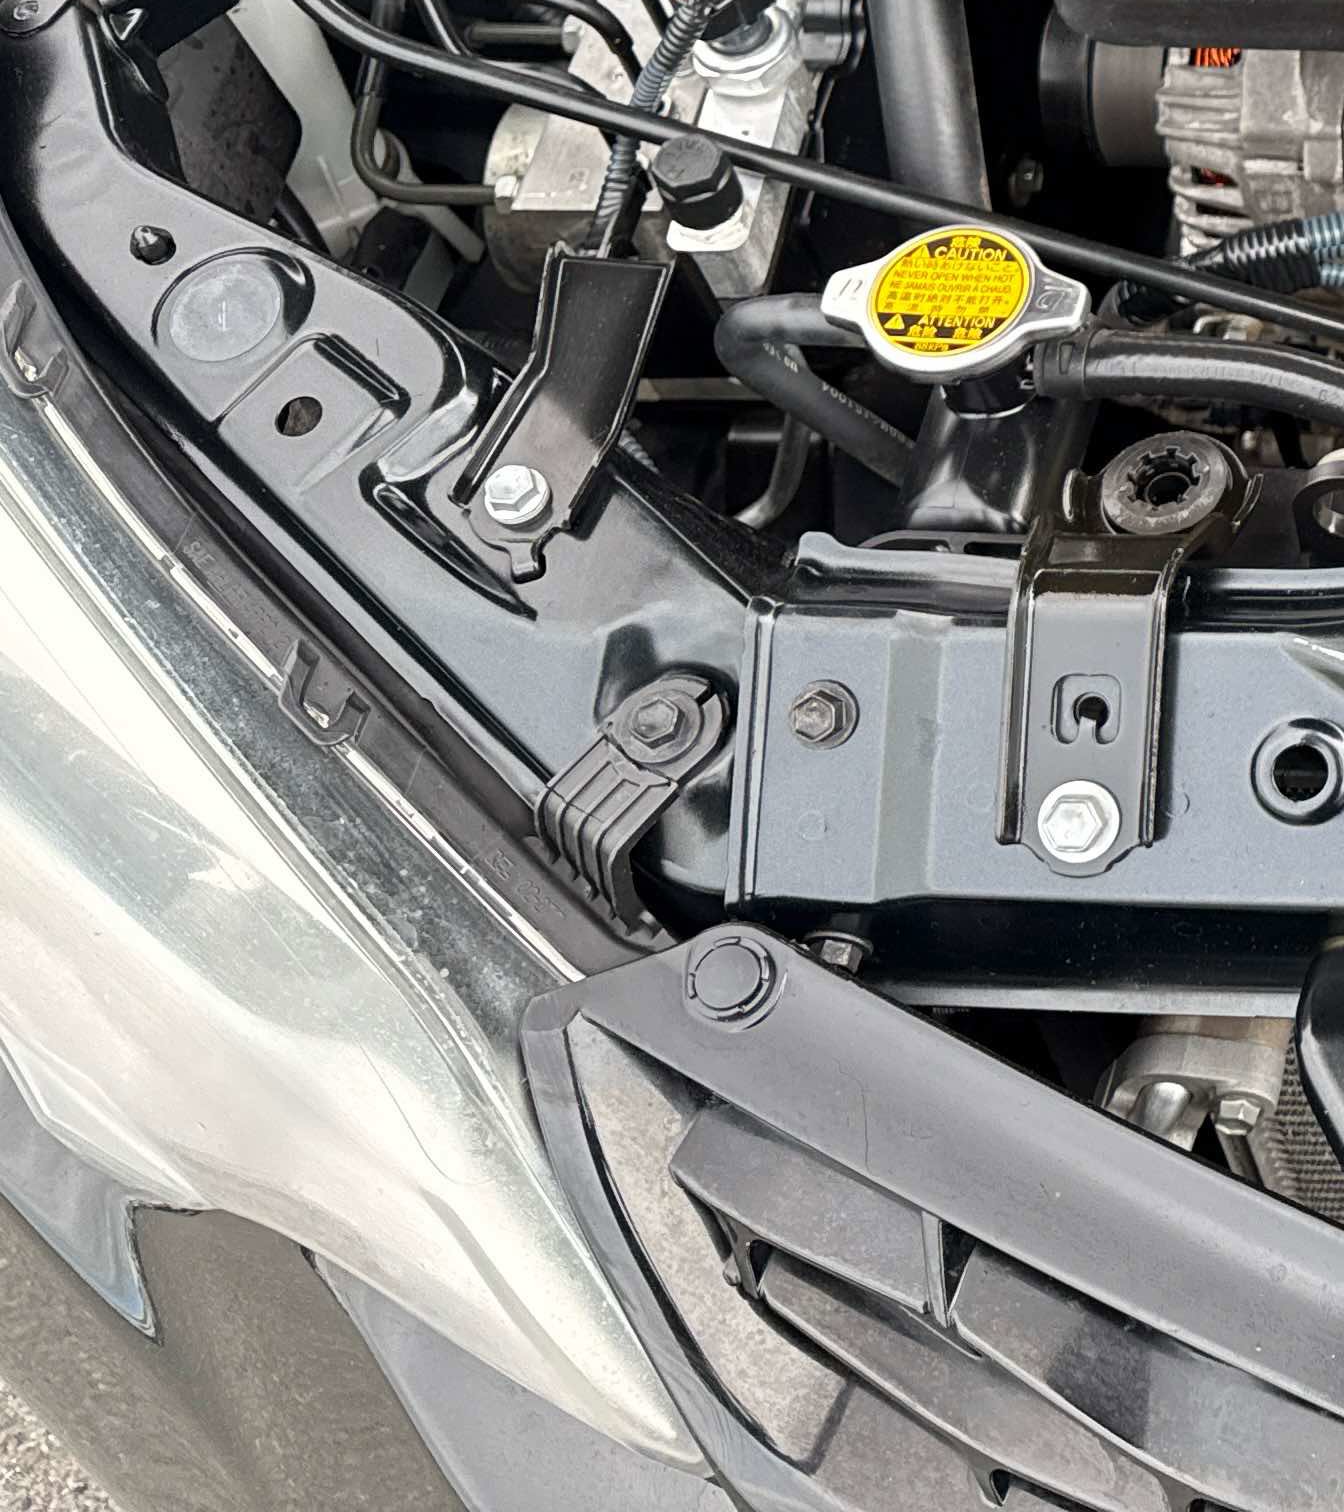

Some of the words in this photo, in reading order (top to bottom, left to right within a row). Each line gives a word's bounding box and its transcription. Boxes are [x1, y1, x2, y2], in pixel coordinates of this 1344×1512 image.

[934, 246, 1007, 261] CAUTION
[894, 270, 928, 279] NEVER
[930, 271, 960, 281] OPEN
[961, 273, 992, 283] WHEN
[992, 274, 1016, 283] HOT
[889, 280, 903, 288] NE
[904, 281, 936, 290] JAMAIS
[938, 283, 971, 292] OUVRIR
[918, 313, 997, 329] ATTENTION
